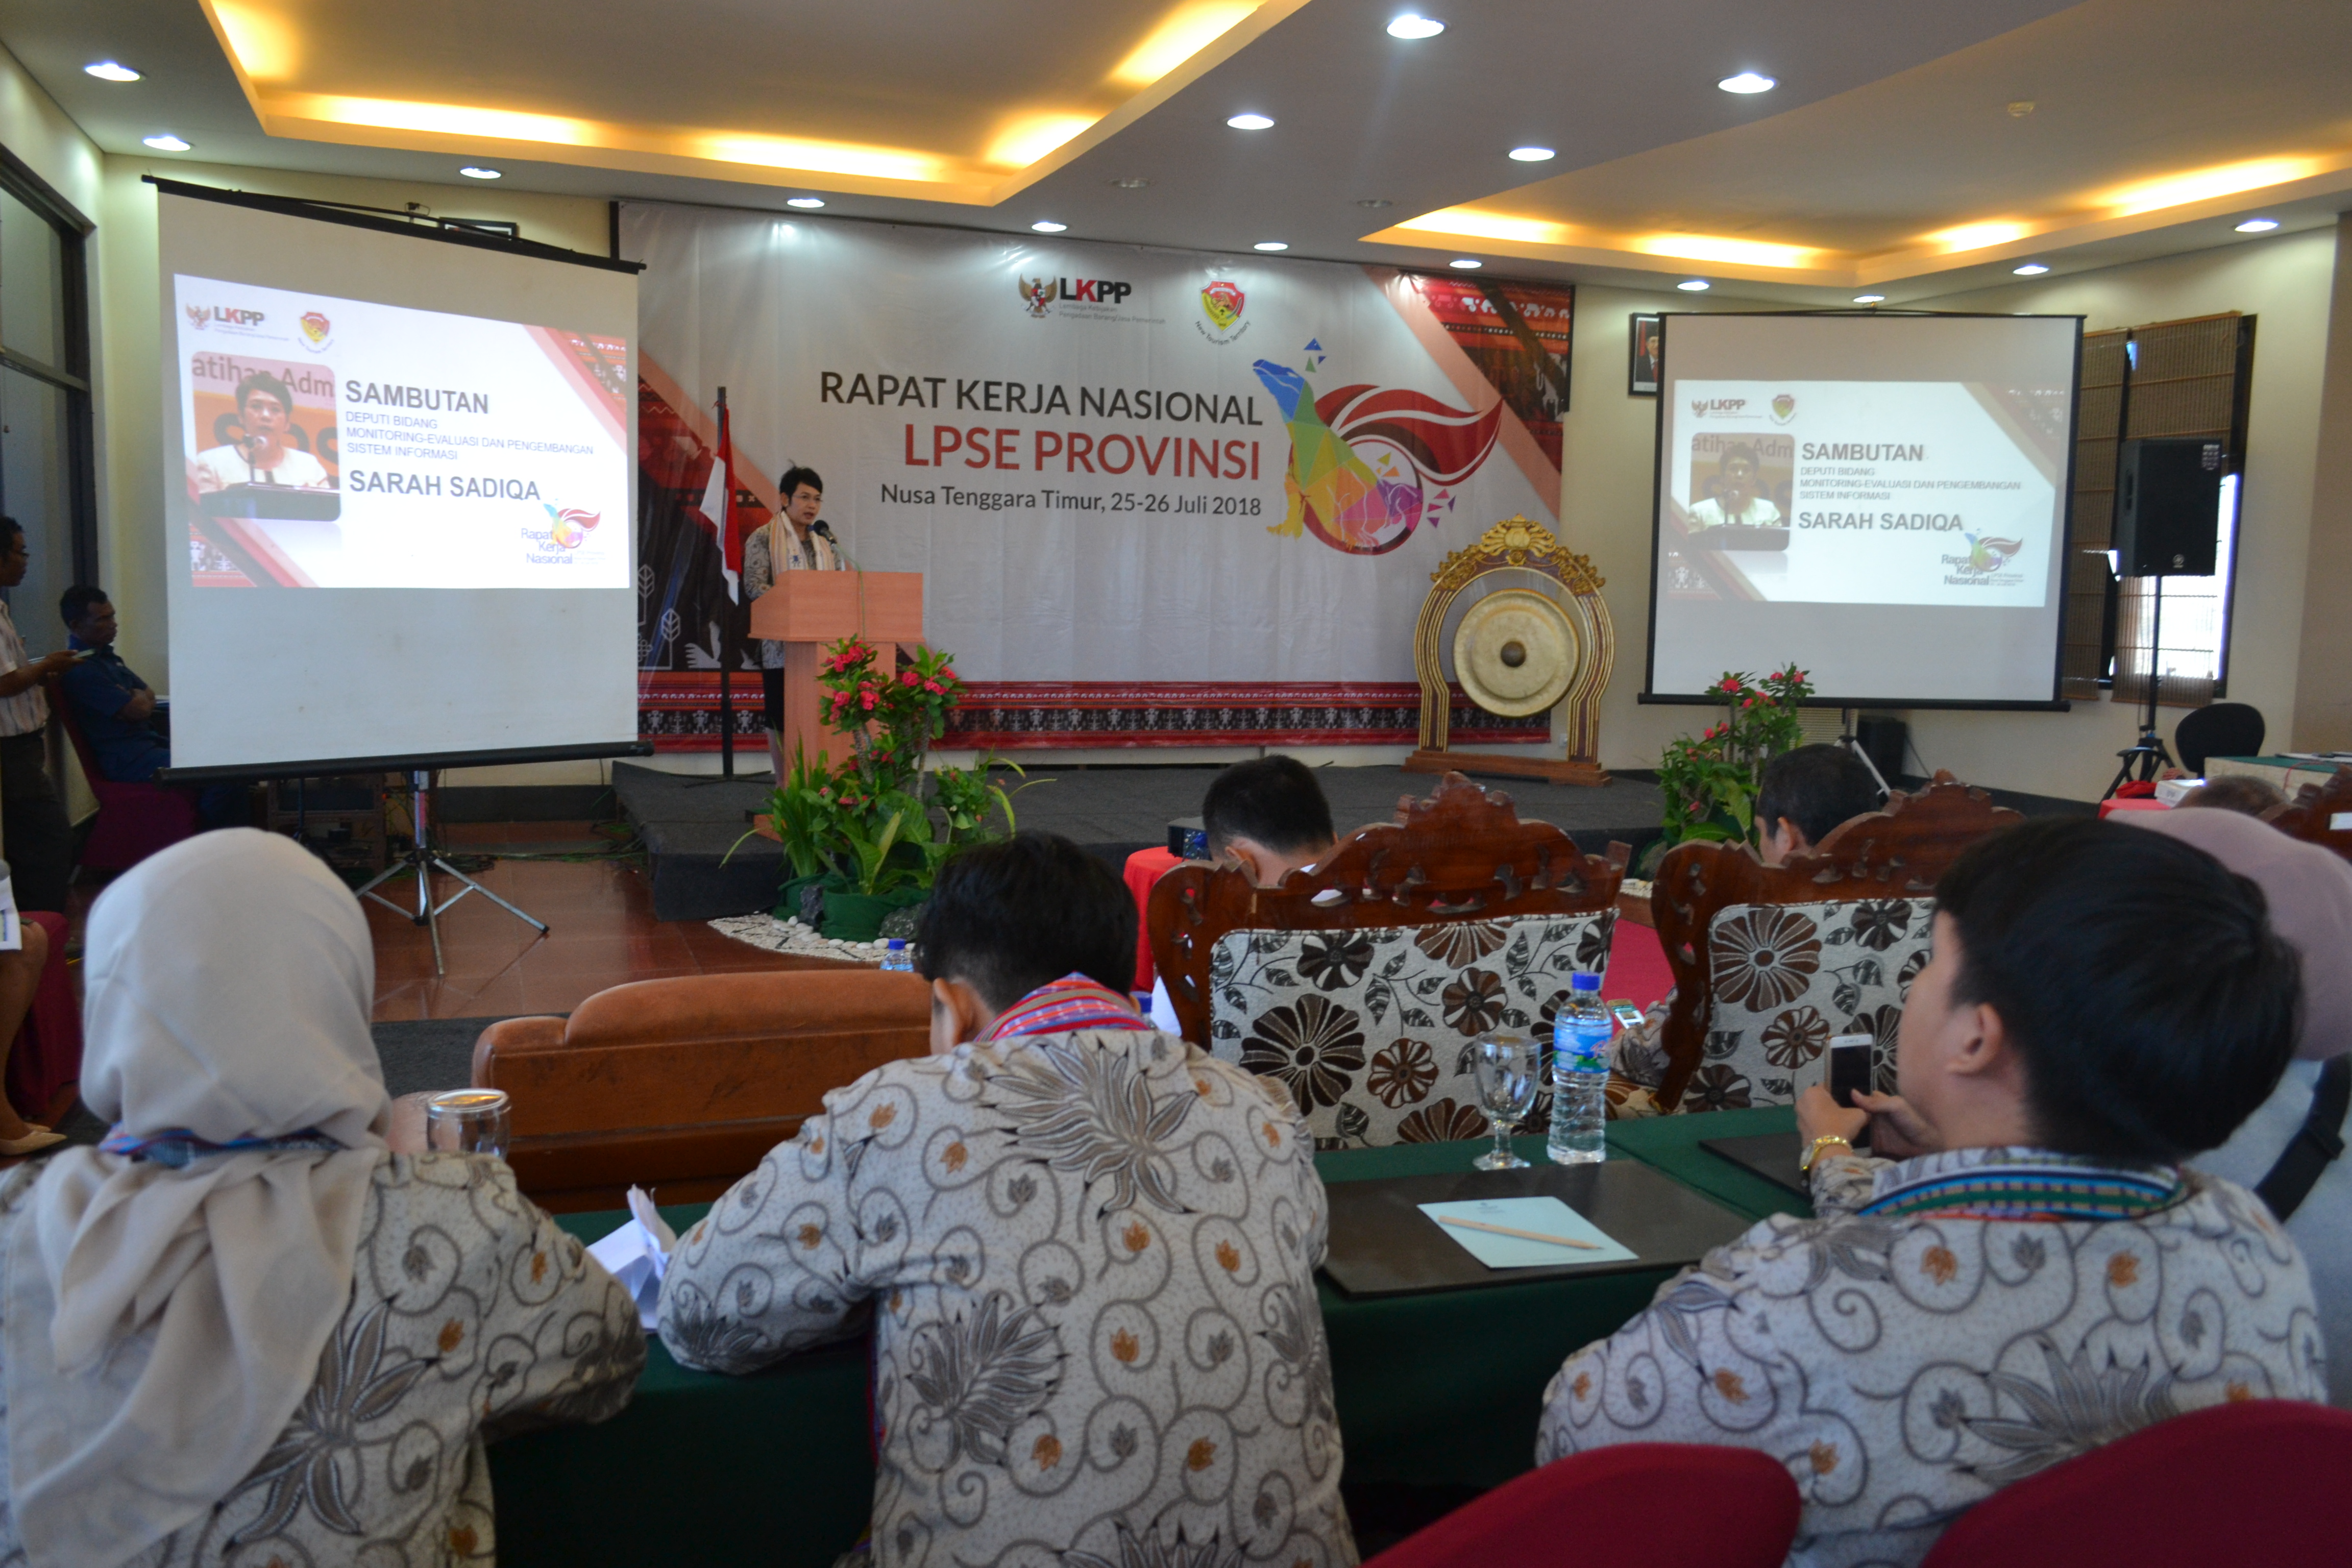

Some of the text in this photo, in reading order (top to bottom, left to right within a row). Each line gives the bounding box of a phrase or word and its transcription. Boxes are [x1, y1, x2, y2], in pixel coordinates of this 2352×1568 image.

[1060, 278, 1132, 304] LKPP
[214, 306, 265, 326] LKPP
[1195, 321, 1206, 335] New
[1206, 333, 1230, 346] Tourism
[191, 356, 272, 381] atih
[346, 380, 489, 414] SAMBUTAN
[821, 371, 1263, 426] RAPAT KERJA NASIONAL
[1710, 399, 1746, 410] LKPP
[346, 411, 438, 429] DEPUTI BIDANG
[347, 427, 594, 455] MONITORING-EVALUASI DAN PENGEMBANGAN
[347, 442, 458, 460] SISTEM INFORMASI
[905, 424, 1259, 481] LPSE PROVINSI
[1802, 443, 1924, 461] SAMBUTAN
[1800, 467, 1875, 476] DEPUTI BIDANG
[349, 470, 541, 500] SARAH SADIQA
[1800, 479, 2022, 490] MONITORING-EVALUASI DAN PENGEMBANGAN
[881, 483, 1261, 516] Nusa Tenggara Timur, 25-26 Juli 2018
[1799, 491, 1891, 500] SISTEM INFORMASI
[1798, 512, 1964, 532] SARAH SADIQA
[521, 527, 553, 542] Rapat
[538, 540, 566, 555] Kerja
[526, 553, 573, 564] Nasional
[1944, 575, 1990, 585] Nasional
